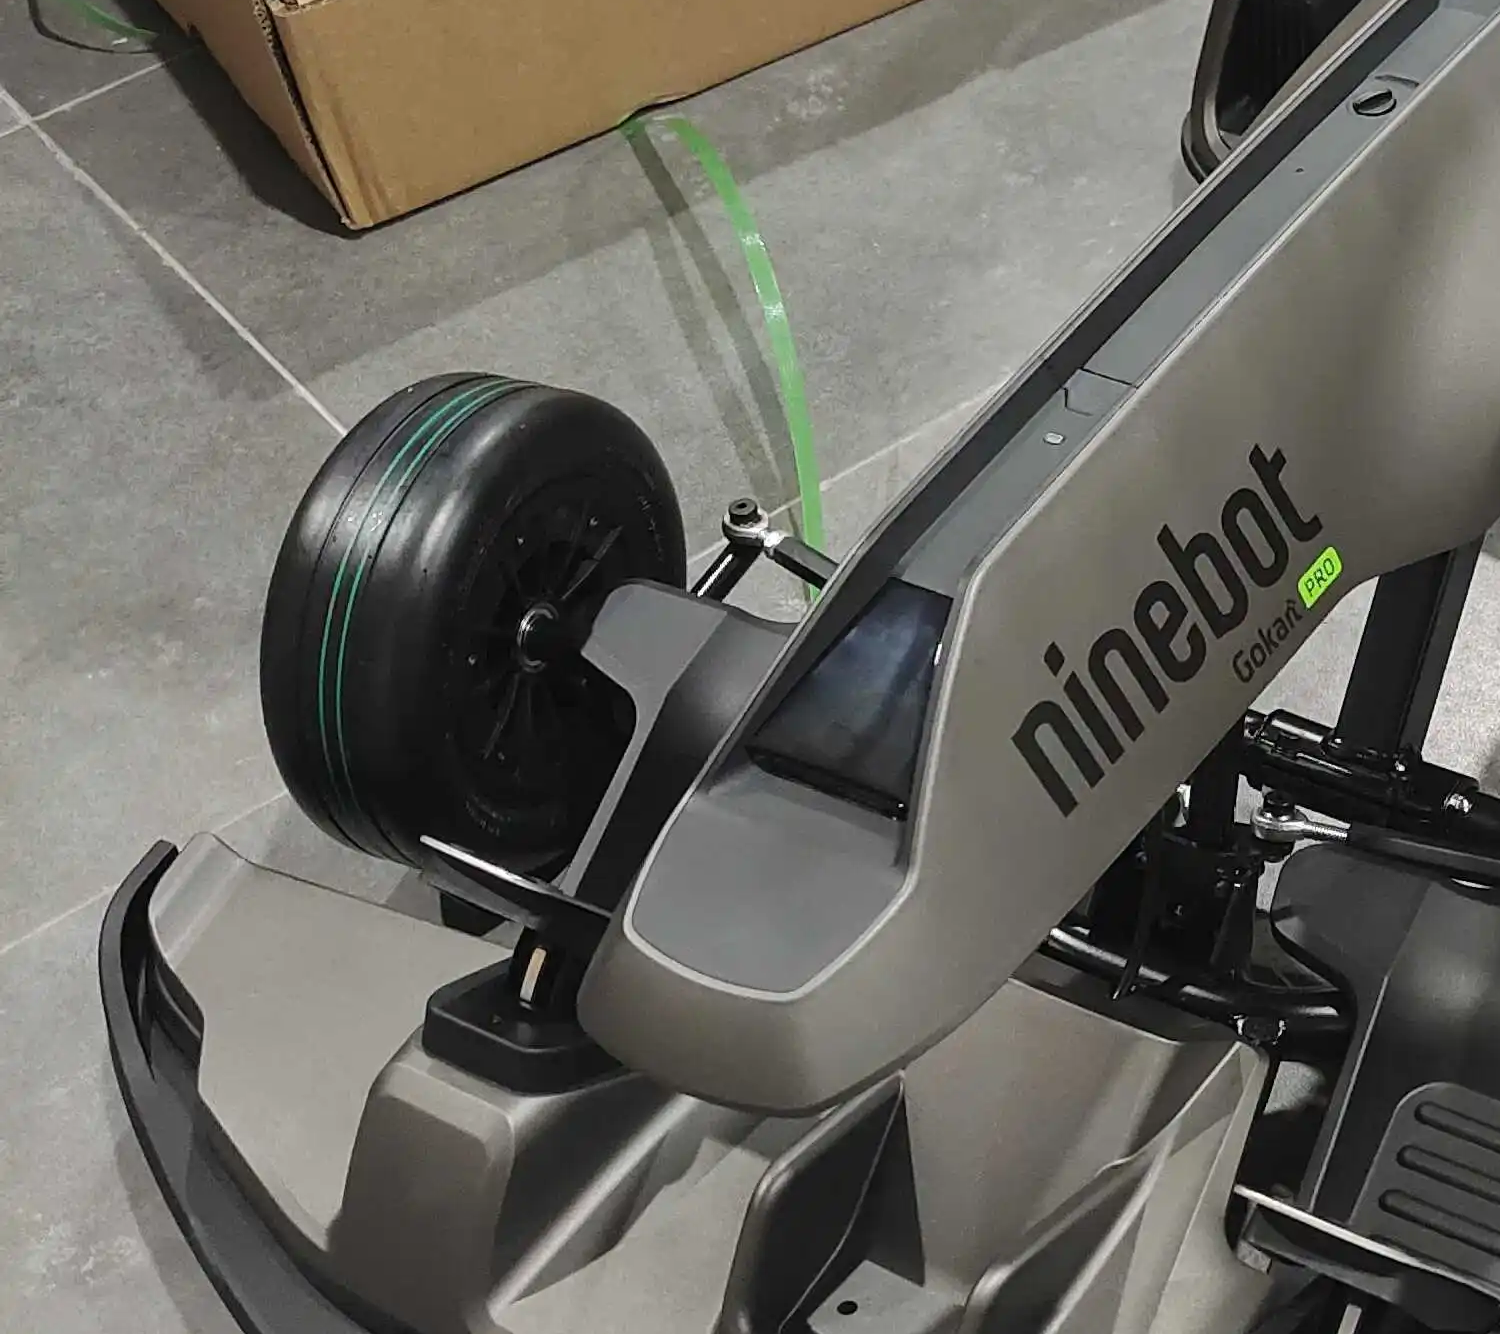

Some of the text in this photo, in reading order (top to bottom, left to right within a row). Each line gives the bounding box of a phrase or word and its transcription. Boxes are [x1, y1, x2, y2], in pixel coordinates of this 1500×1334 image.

[1010, 442, 1323, 817] ninebot
[1231, 557, 1336, 684] Gokart PRO
